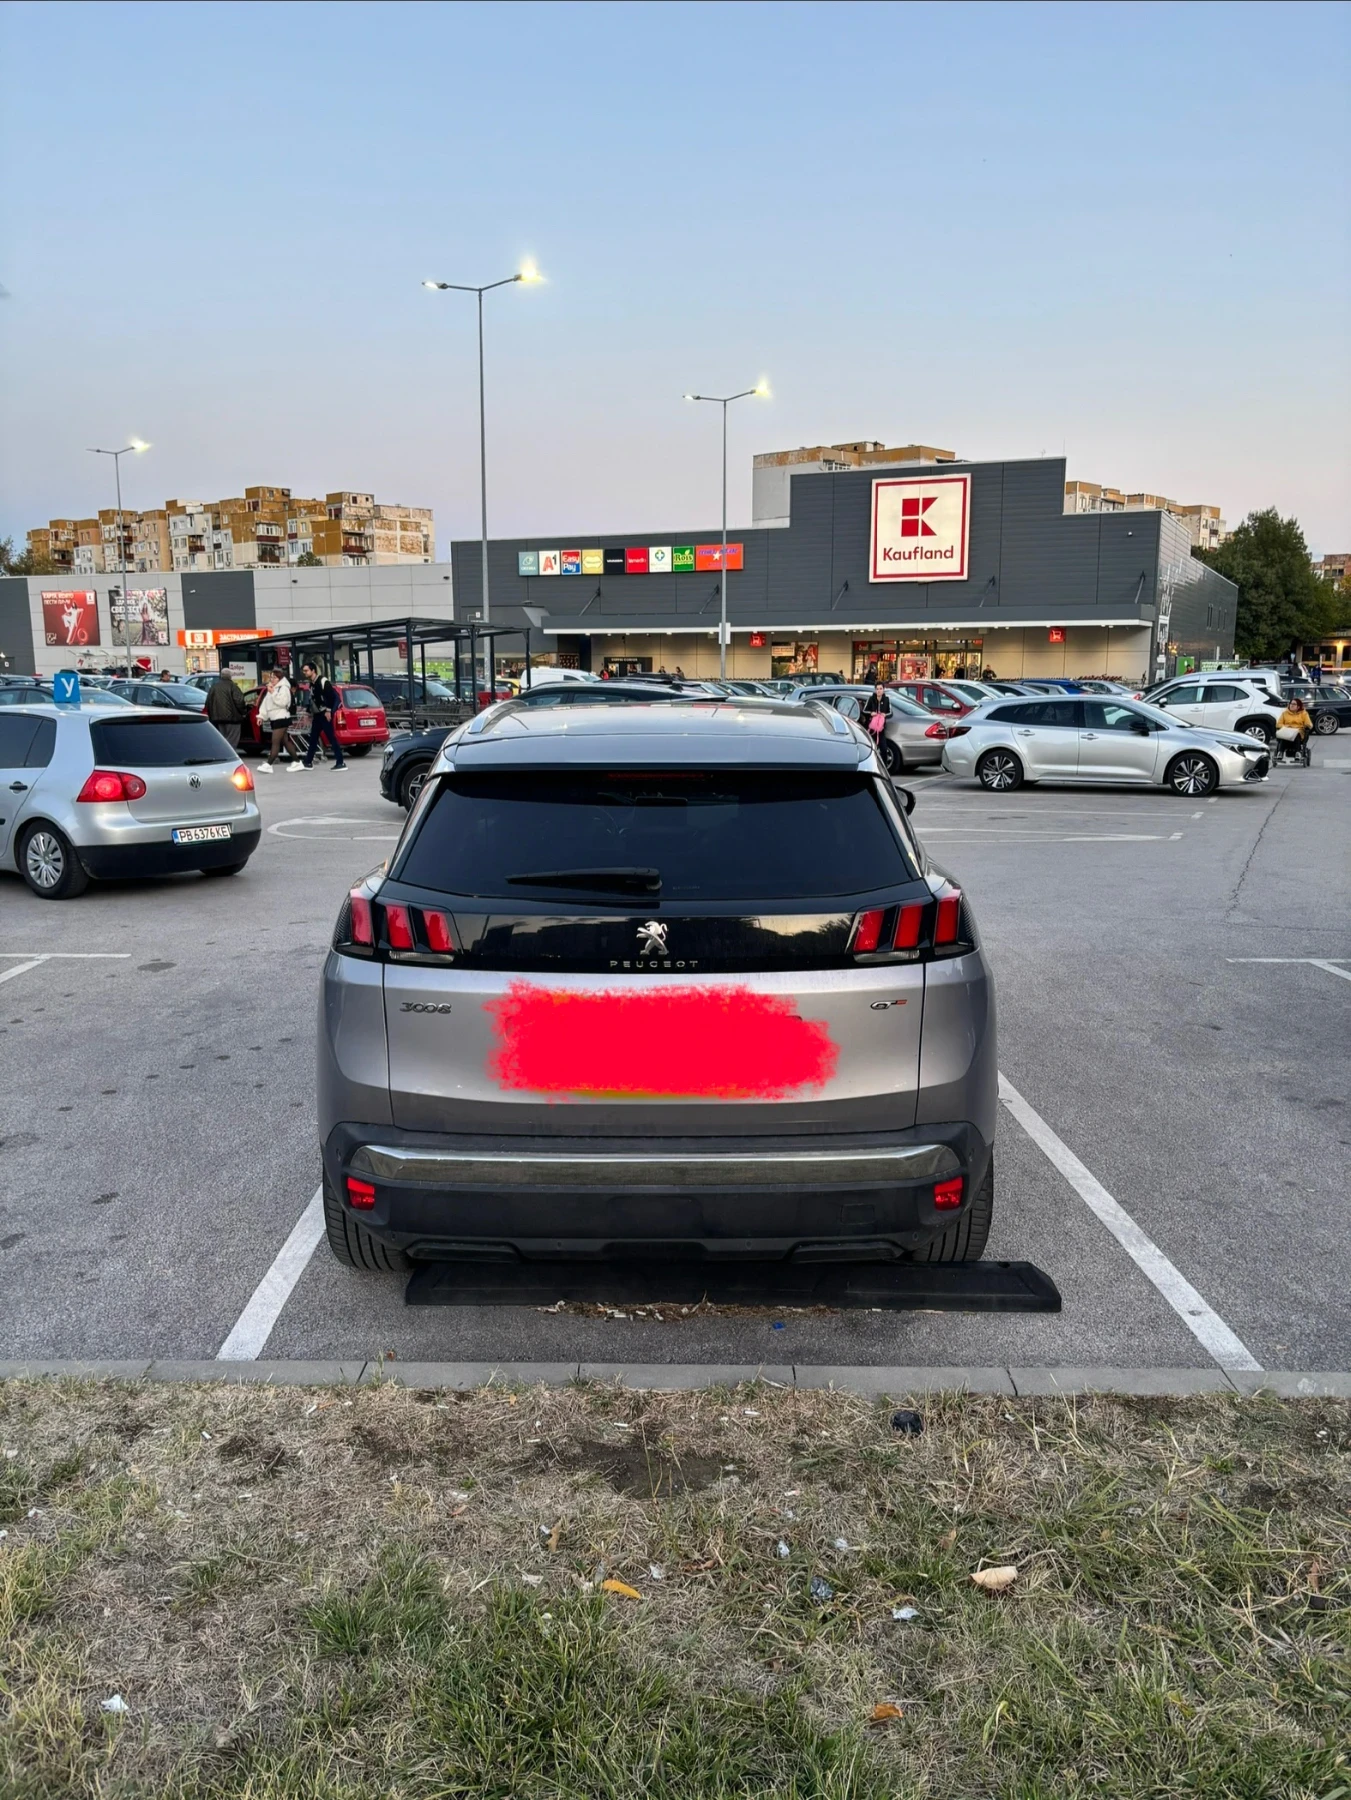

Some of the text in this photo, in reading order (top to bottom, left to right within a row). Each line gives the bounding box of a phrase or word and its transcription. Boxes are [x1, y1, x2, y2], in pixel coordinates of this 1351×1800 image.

[883, 545, 954, 562] Kaufland
[543, 553, 557, 572] A1
[562, 555, 580, 565] Easy
[563, 563, 577, 572] Pay
[610, 960, 699, 968] PEUGEOT
[399, 1001, 452, 1014] 3008
